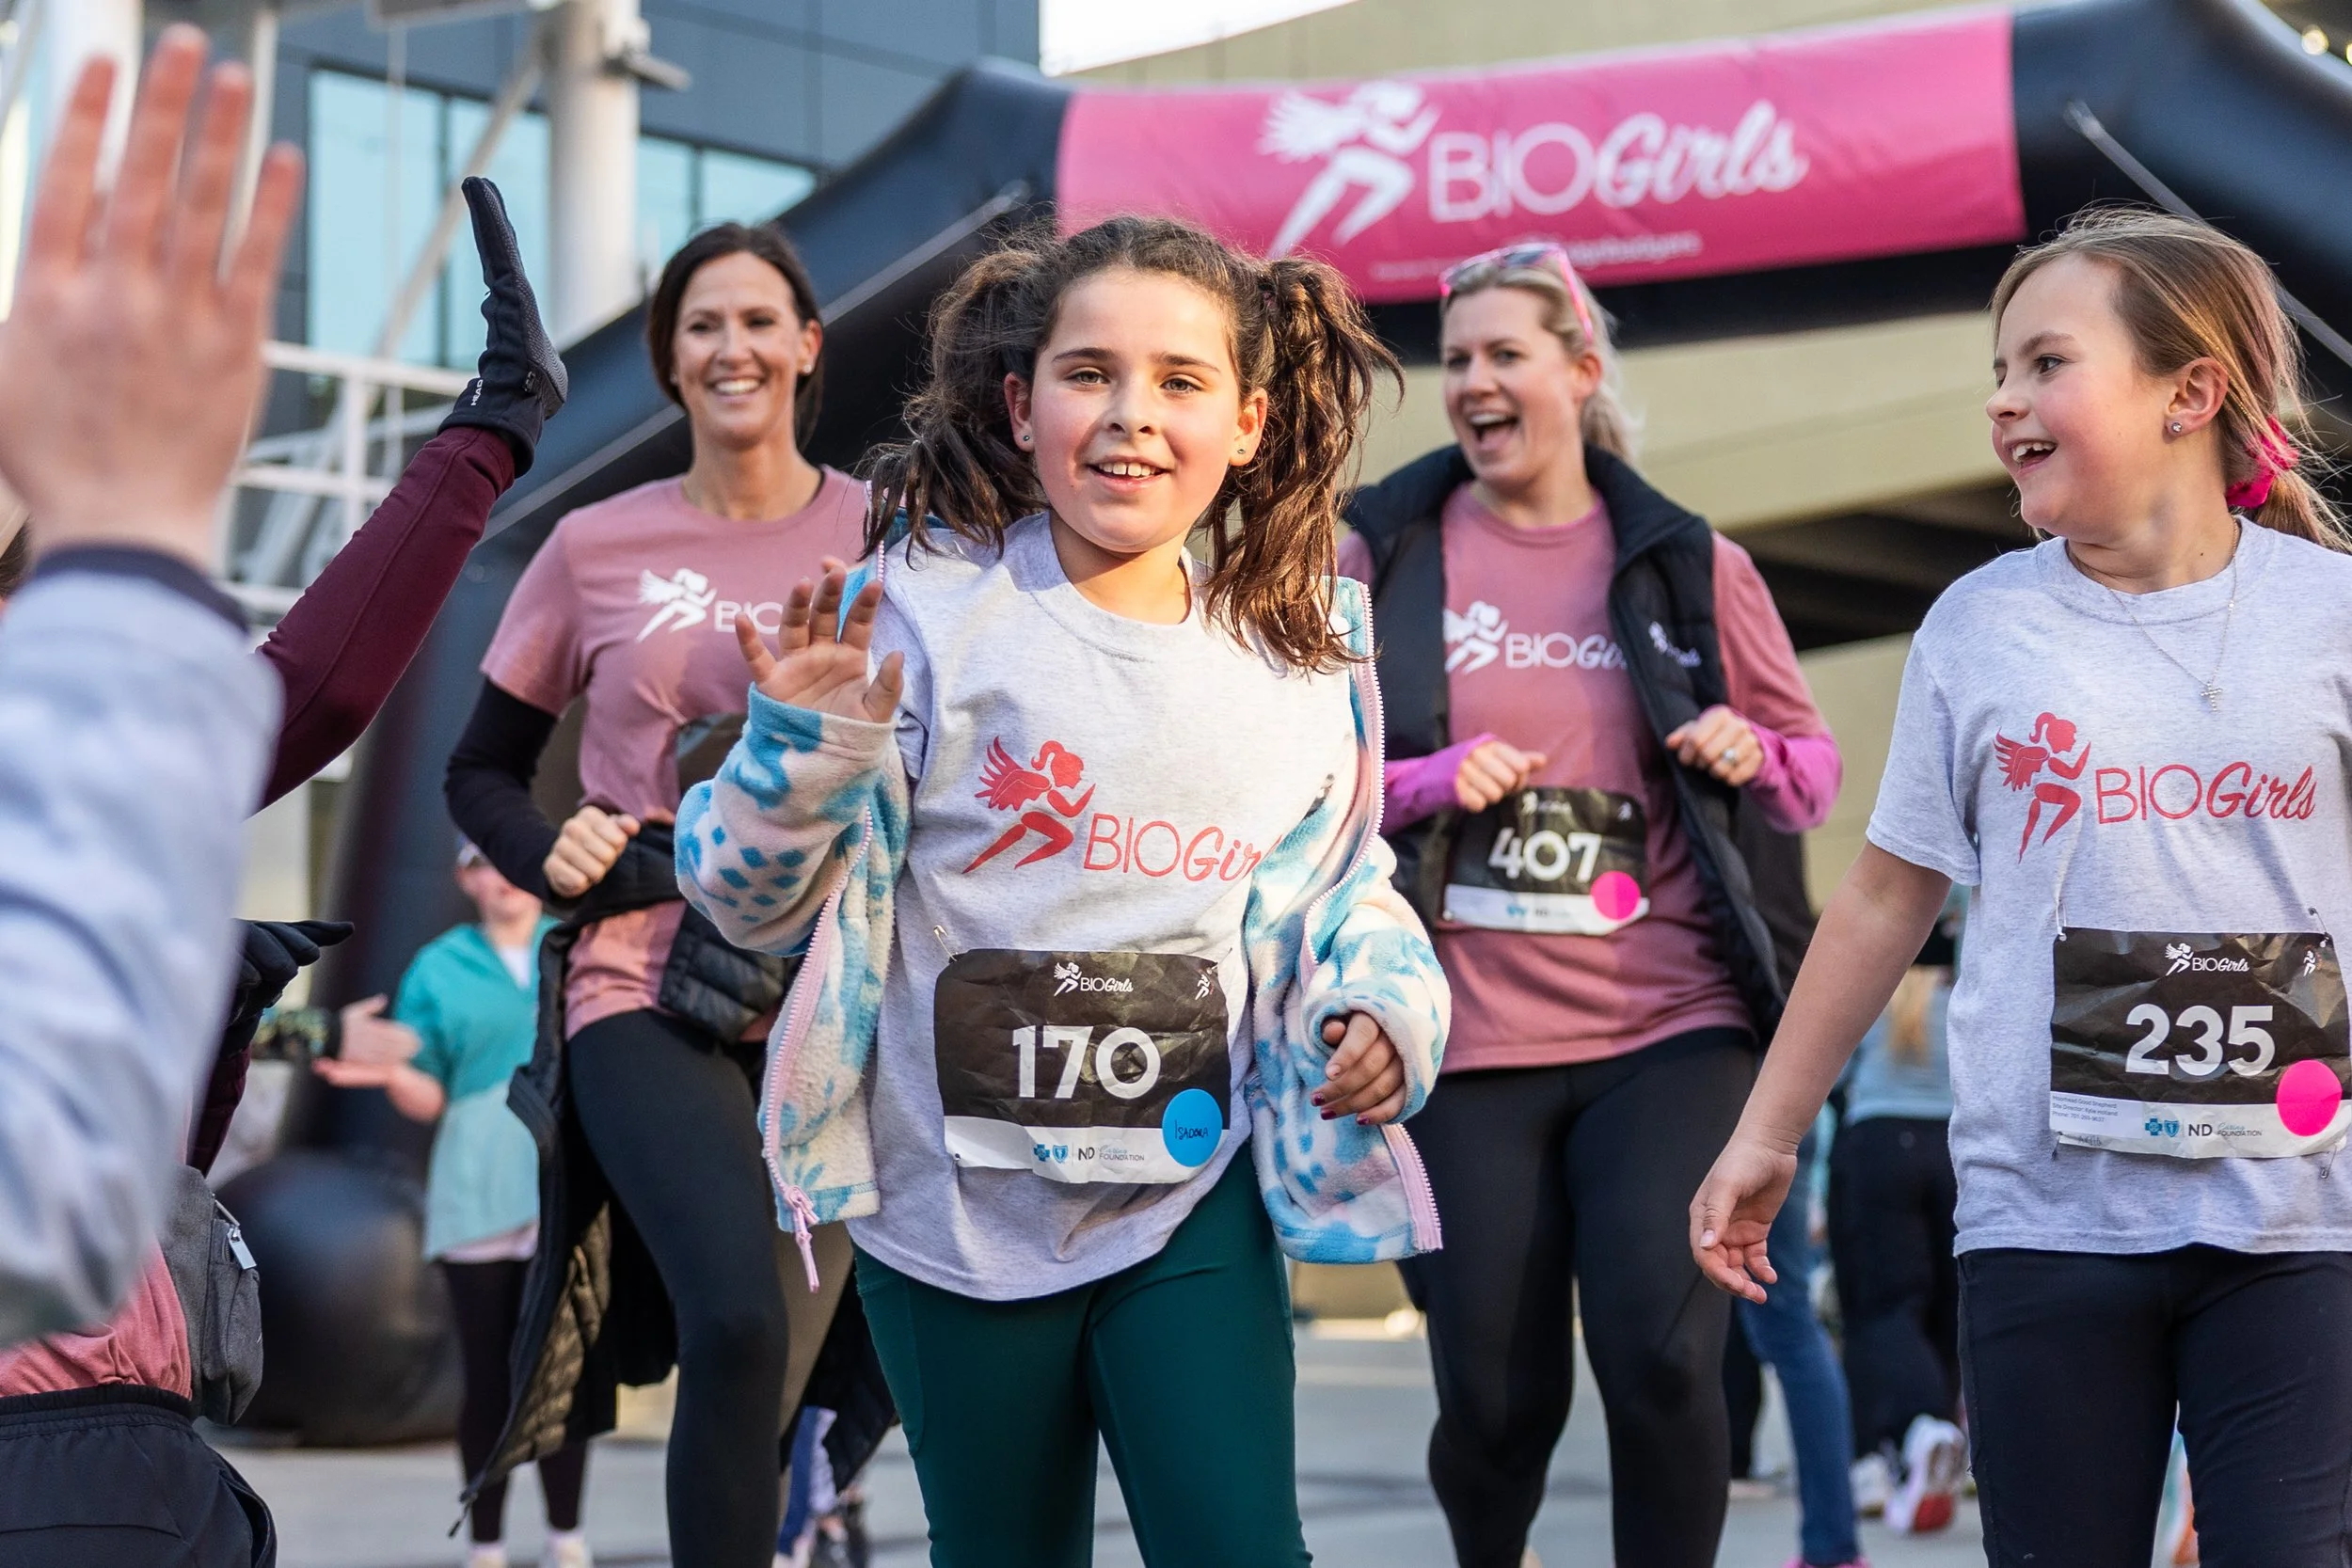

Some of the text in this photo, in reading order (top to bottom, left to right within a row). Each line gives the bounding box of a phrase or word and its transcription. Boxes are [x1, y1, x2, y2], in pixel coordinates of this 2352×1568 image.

[1427, 98, 1810, 224] BIOGirls
[470, 379, 484, 406] HEAD
[2095, 761, 2317, 825] BIOGirls
[1084, 813, 1282, 881] BIOGir
[1487, 827, 1602, 884] 407
[1079, 976, 1134, 993] BIOGirls
[2191, 957, 2250, 973] BIOGirls
[2125, 1003, 2276, 1077] 235
[1012, 1024, 1162, 1100] 170
[2188, 1123, 2213, 1136] ND
[1078, 1147, 1095, 1161] ND
[1099, 1153, 1145, 1162] FOUNDATION
